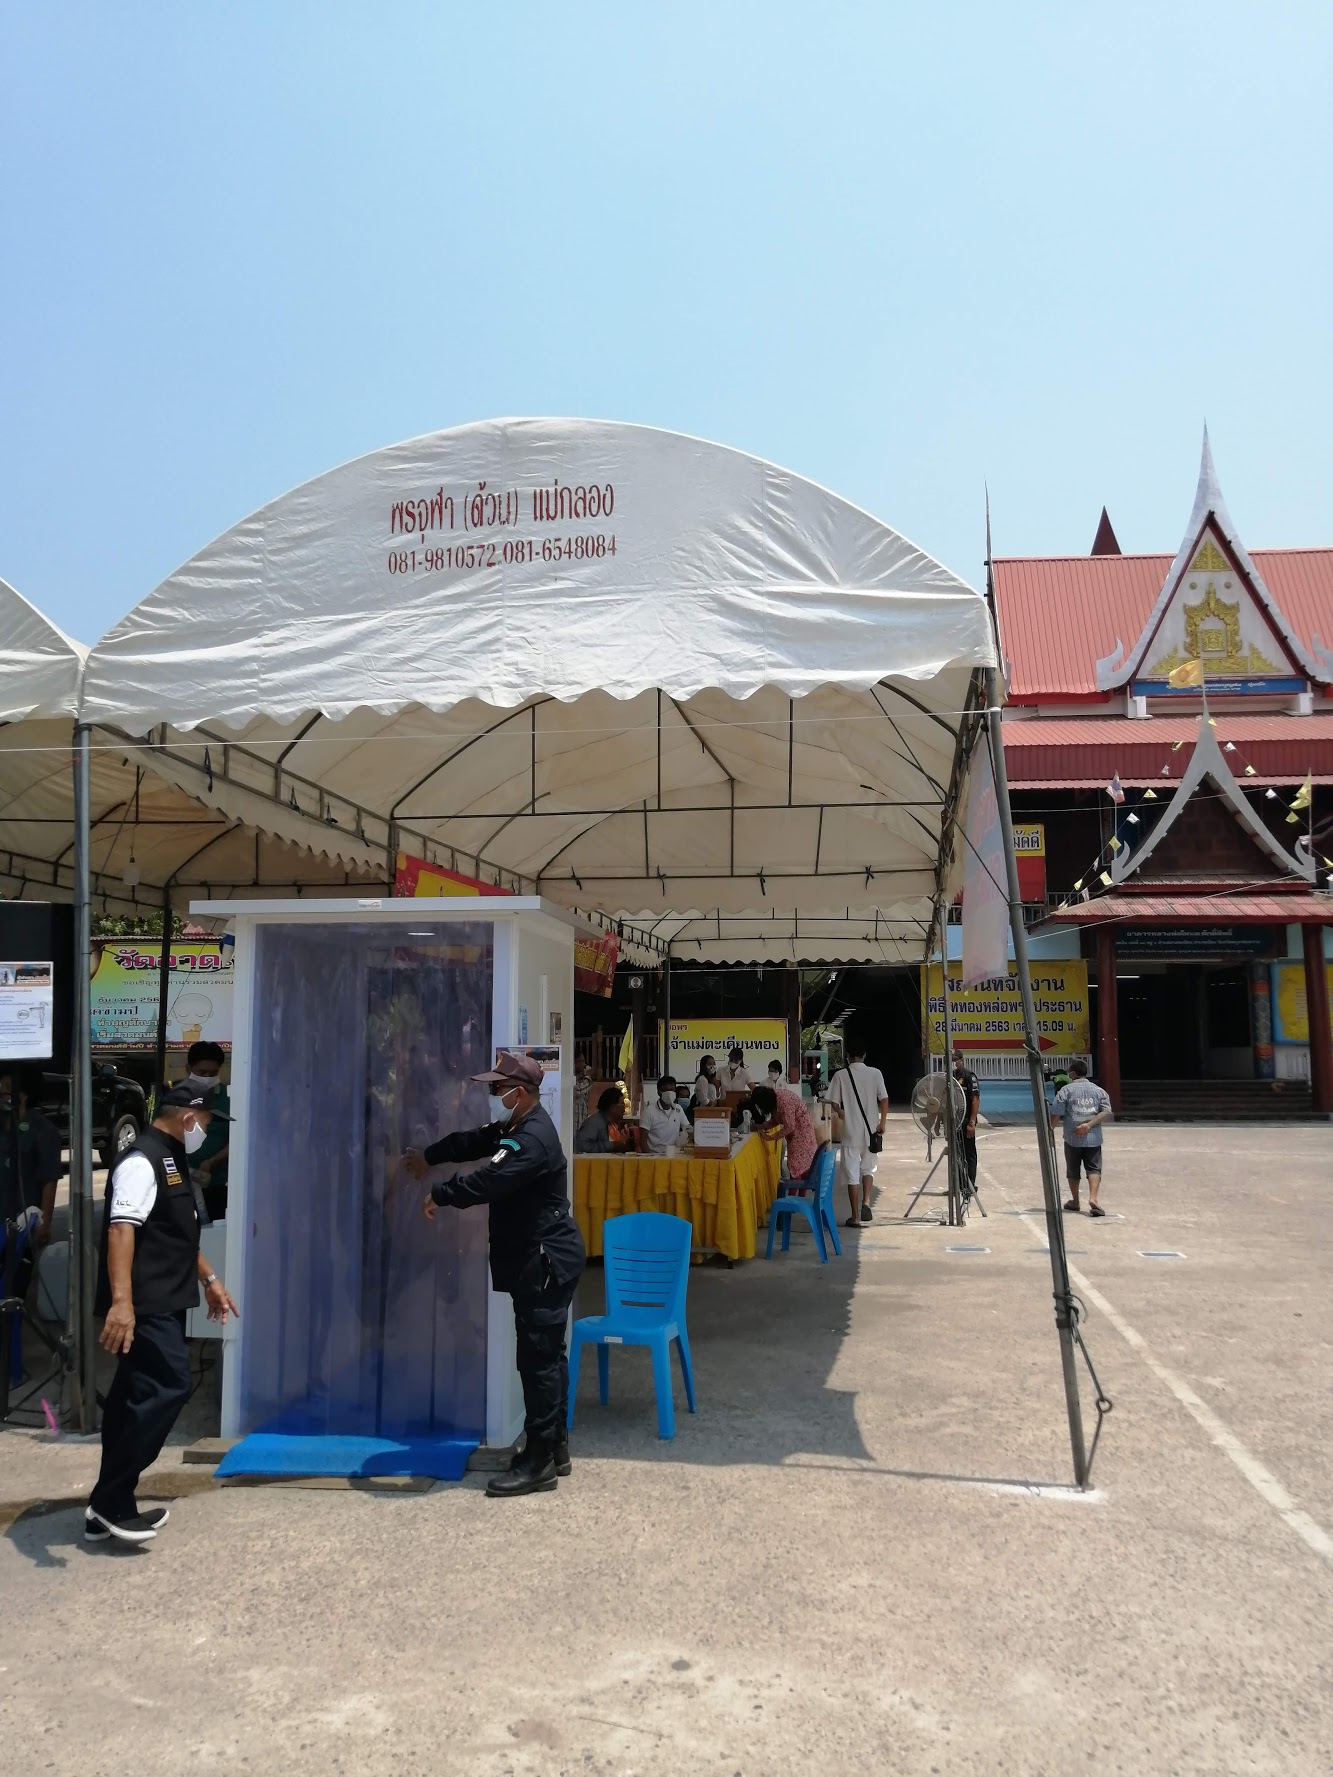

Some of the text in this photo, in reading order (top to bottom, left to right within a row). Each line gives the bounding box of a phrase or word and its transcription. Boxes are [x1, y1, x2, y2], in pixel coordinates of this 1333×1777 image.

[533, 478, 615, 521] แม่กลอง
[928, 996, 1083, 1013] พิธีททองหล่อพรประธาน
[97, 1018, 172, 1029] ทำบุญตักบาร
[950, 1017, 982, 1032] มีนาคม
[985, 1020, 1010, 1032] 2563
[1036, 1020, 1064, 1032] 15.09
[669, 1035, 780, 1050] จ้าแม่ตะเคียนทอง
